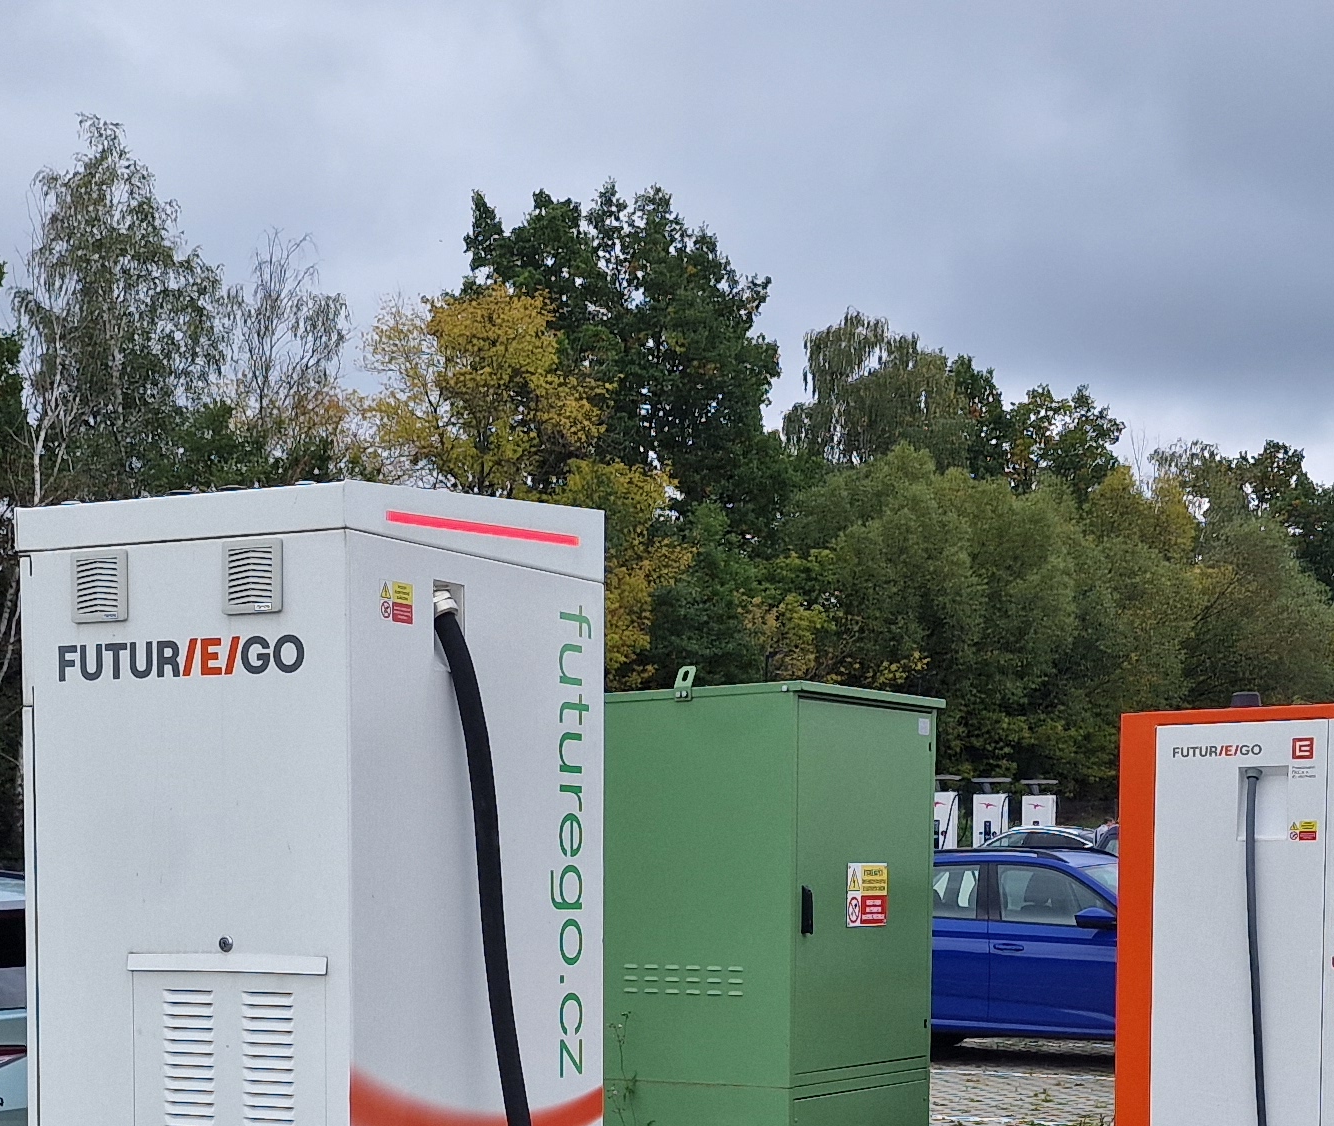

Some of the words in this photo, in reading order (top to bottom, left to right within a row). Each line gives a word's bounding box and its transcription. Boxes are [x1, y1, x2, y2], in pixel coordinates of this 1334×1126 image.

[58, 634, 304, 681] FUTUR/E/GO
[1172, 743, 1263, 758] FUTUR/E/GO
[549, 605, 592, 1078] futurego.cz
